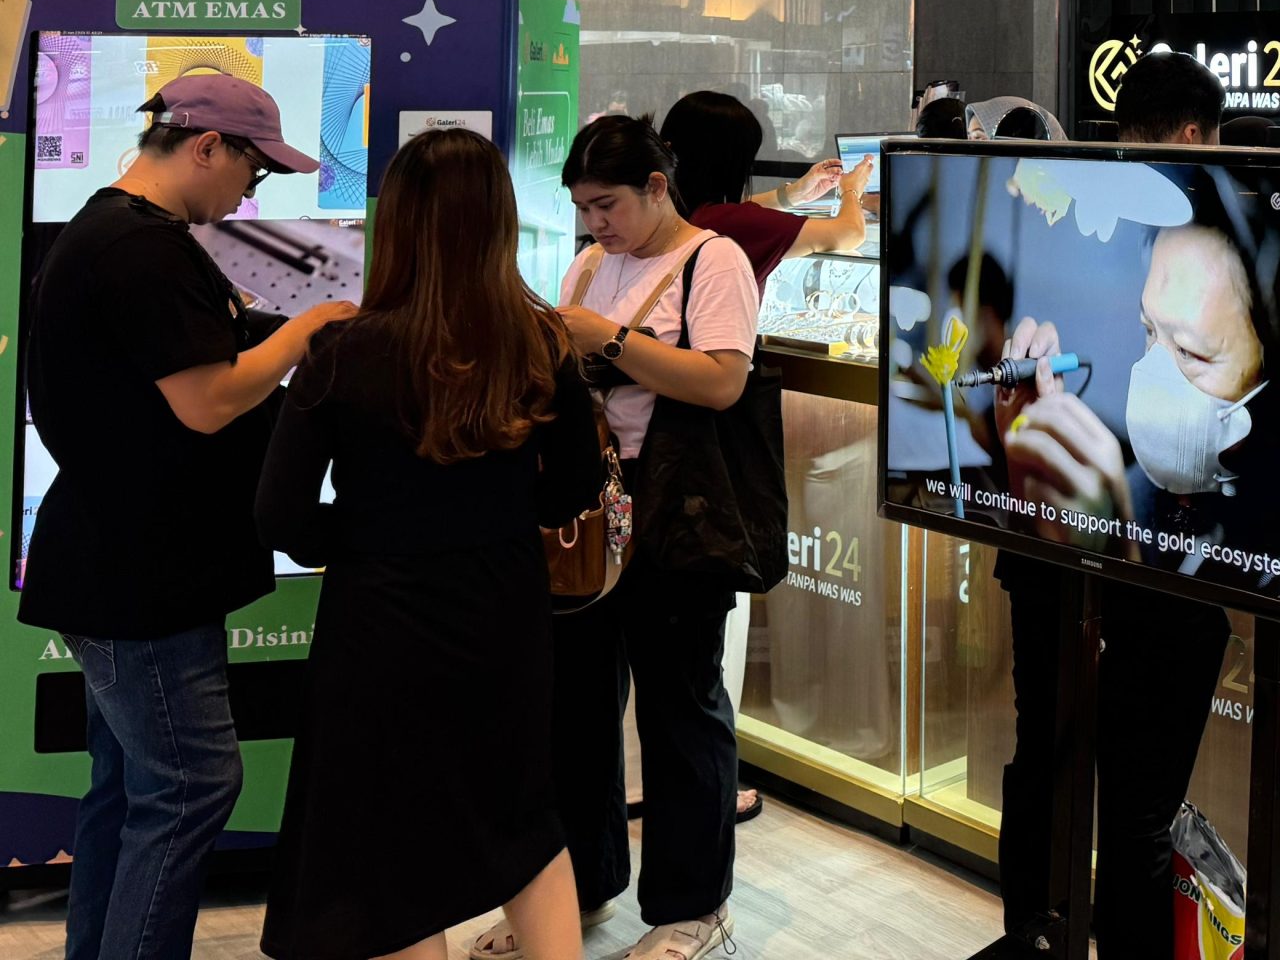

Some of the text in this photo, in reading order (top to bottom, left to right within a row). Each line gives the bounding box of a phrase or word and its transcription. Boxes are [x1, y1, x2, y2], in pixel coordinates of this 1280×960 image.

[132, 1, 286, 19] ATM EMAS
[1224, 92, 1249, 108] NPA
[1252, 92, 1280, 108] WAS
[523, 107, 555, 136] Beli Emas
[926, 478, 945, 495] we
[949, 480, 971, 501] will
[975, 489, 1036, 517] continue
[1041, 502, 1056, 521] to
[1060, 510, 1121, 536] support
[1126, 520, 1153, 544] the
[1157, 530, 1195, 555] gold
[788, 526, 861, 582] eri 24
[1081, 558, 1102, 569] SAMSUNG
[786, 571, 862, 606] TANPA WAS WAS
[1211, 696, 1242, 721] WAS
